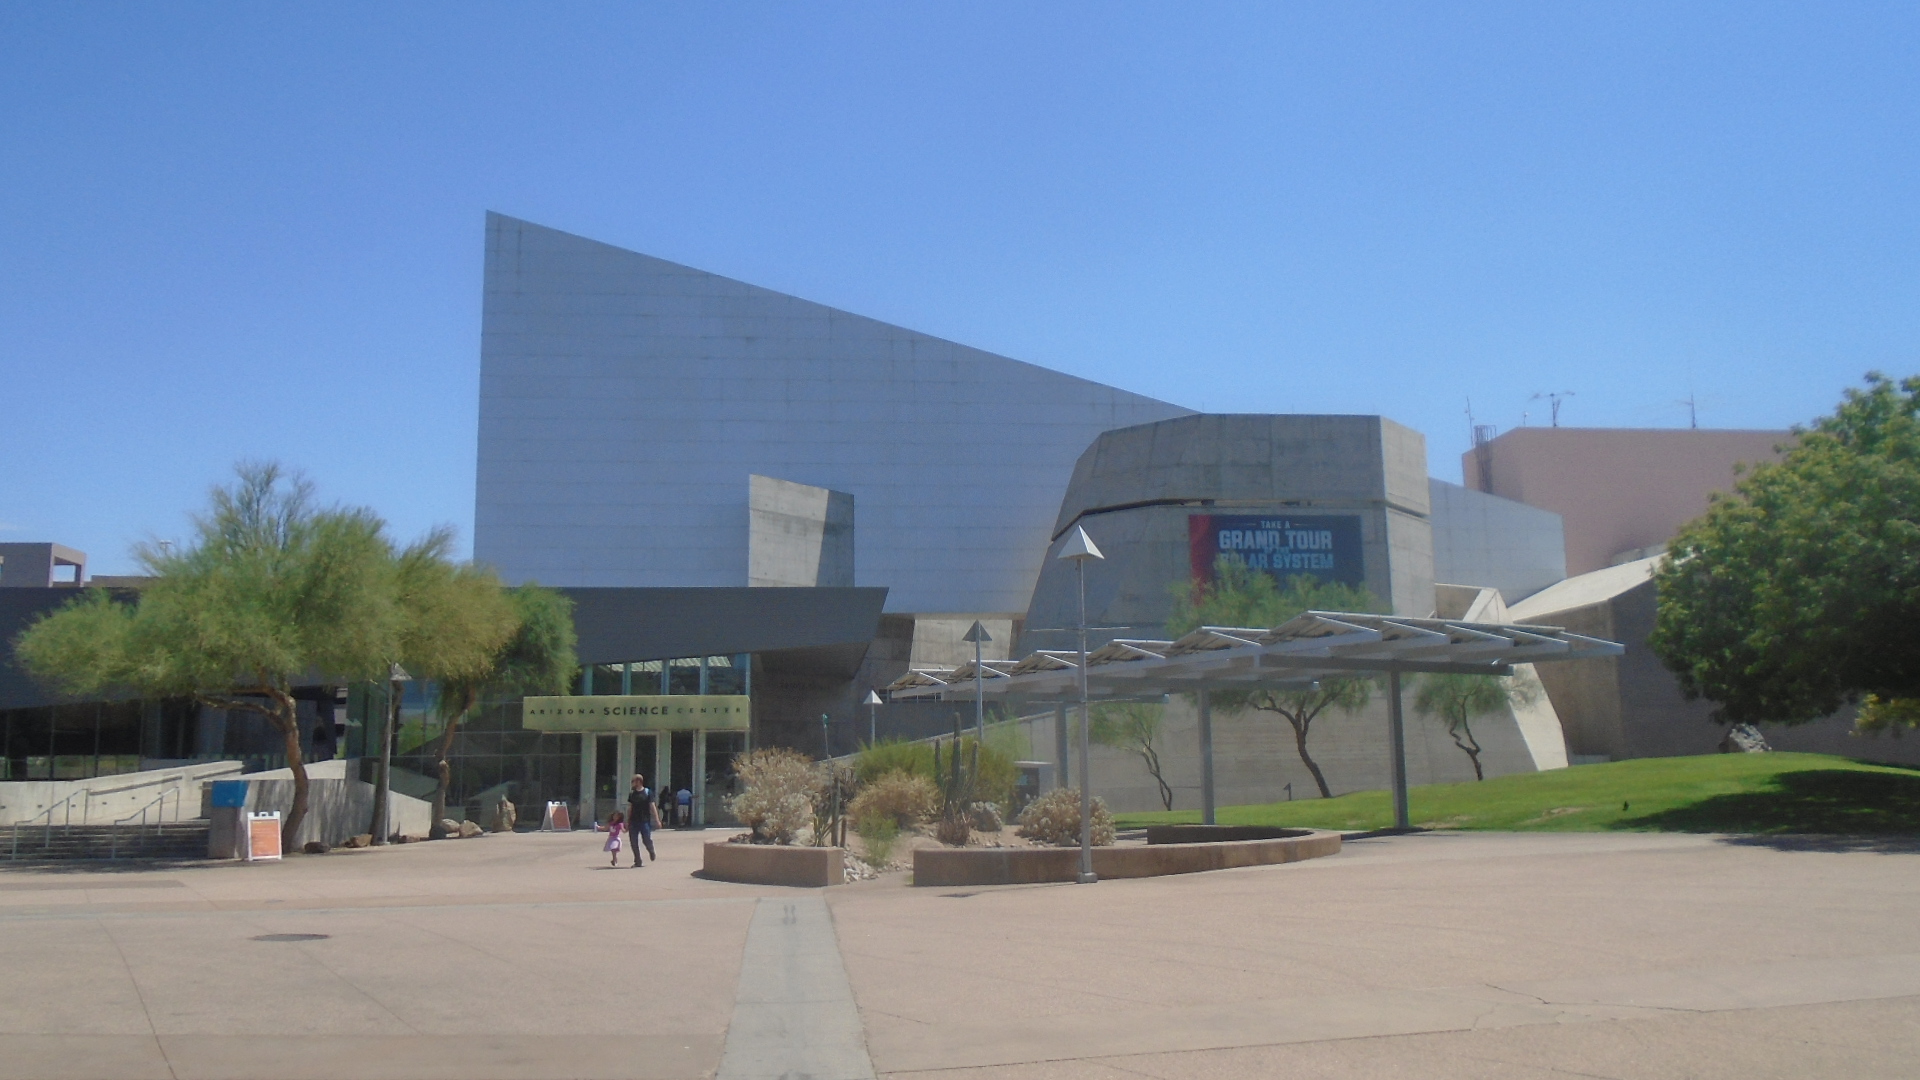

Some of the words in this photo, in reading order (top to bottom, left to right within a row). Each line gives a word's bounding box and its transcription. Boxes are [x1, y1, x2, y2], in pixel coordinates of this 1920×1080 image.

[1261, 520, 1282, 529] TAKE
[1284, 520, 1291, 529] A
[1219, 531, 1280, 549] GRAND
[1285, 531, 1332, 549] TOUR
[1273, 553, 1334, 569] SYSTEM
[603, 706, 669, 716] SCIENCE
